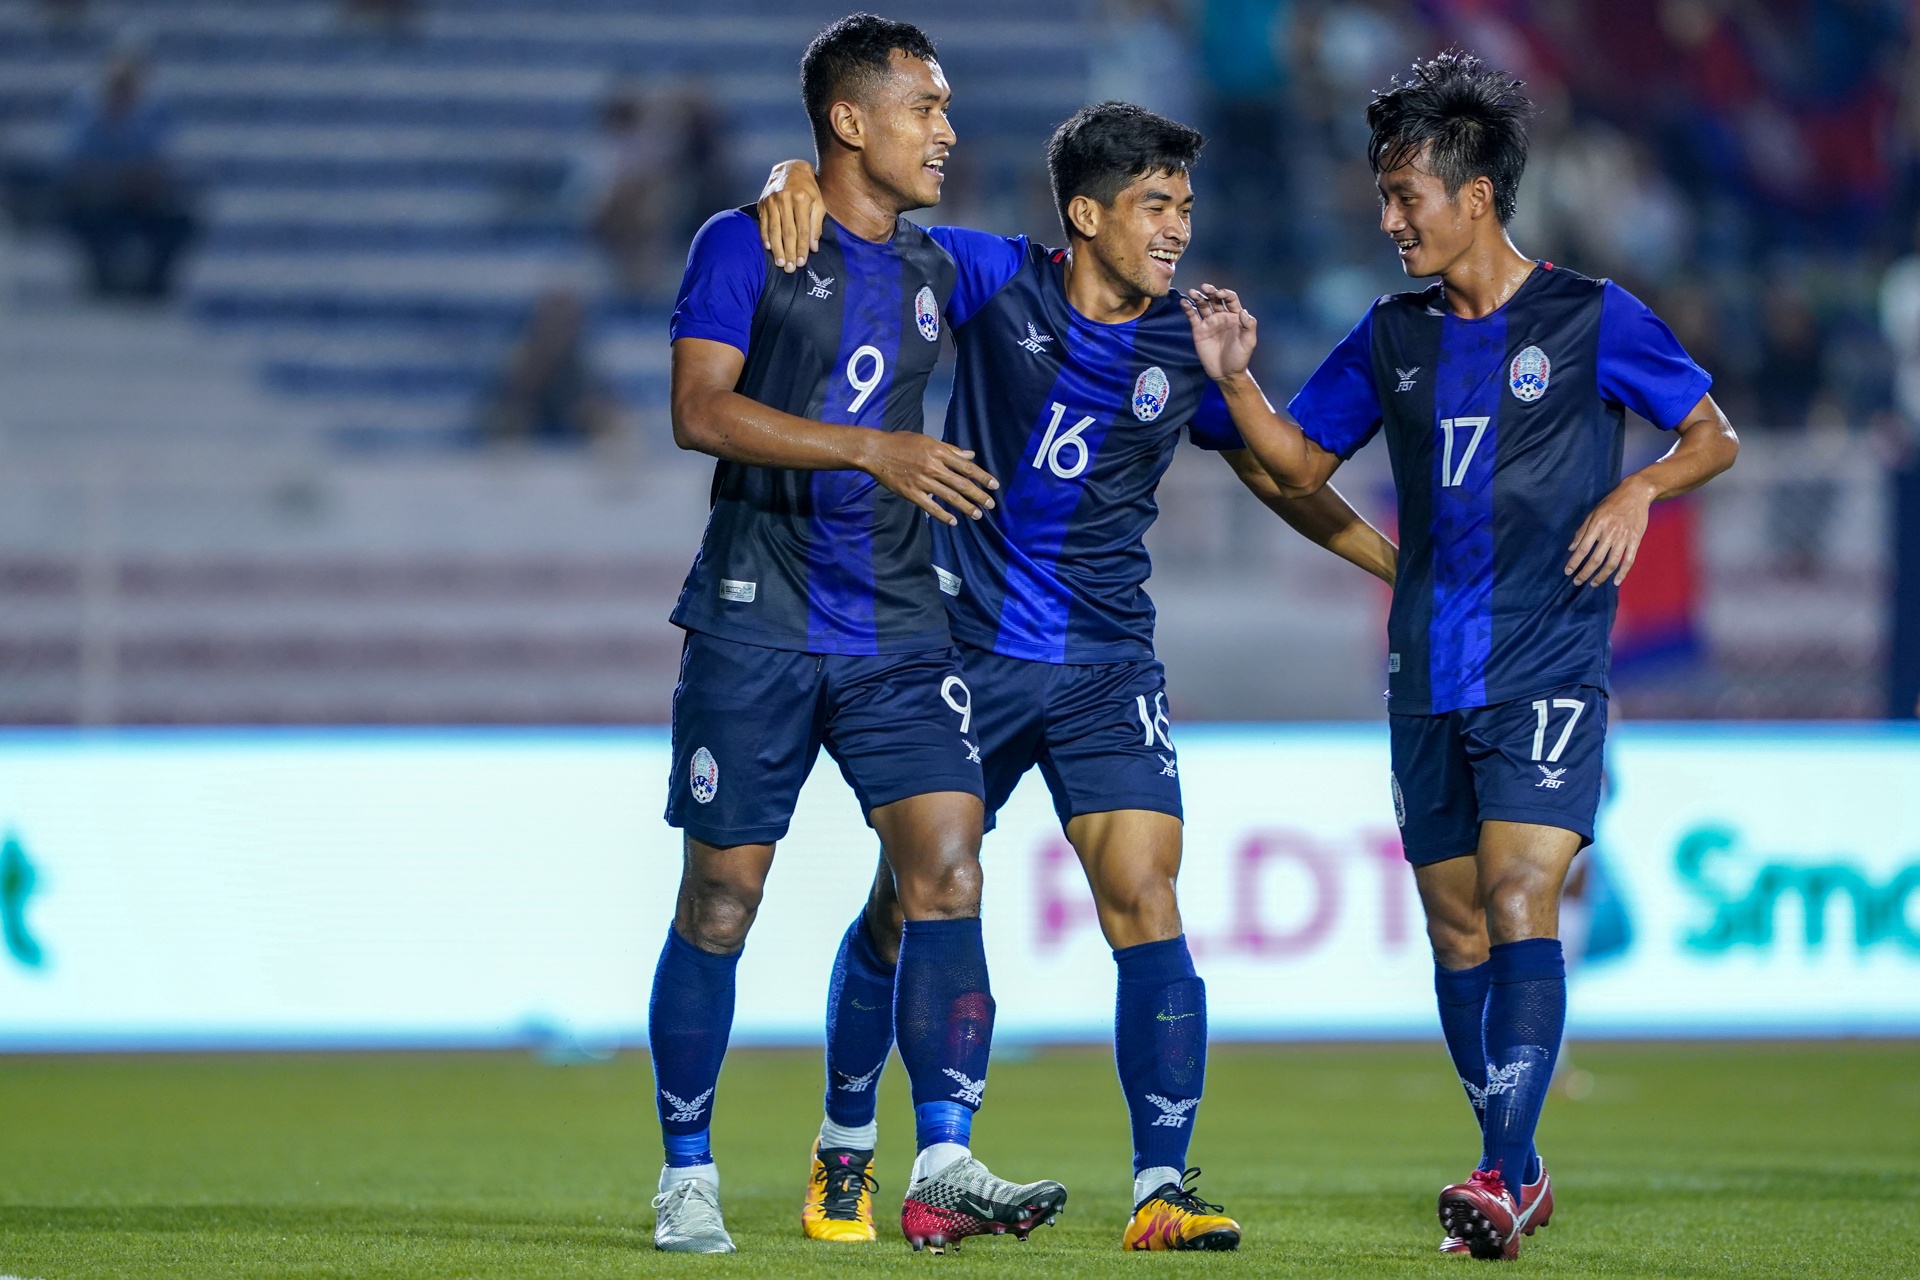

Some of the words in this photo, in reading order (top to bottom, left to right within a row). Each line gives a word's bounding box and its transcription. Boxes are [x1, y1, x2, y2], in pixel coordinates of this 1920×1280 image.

[807, 287, 833, 300] FBT
[1017, 338, 1047, 354] FBT
[846, 345, 885, 413] 9
[1395, 380, 1417, 392] FBT
[1519, 375, 1539, 384] FFC
[1032, 401, 1096, 479] 16
[1440, 416, 1491, 487] 17
[941, 675, 971, 734] 9
[1531, 698, 1586, 762] 17
[1159, 767, 1178, 778] FBT
[1535, 779, 1566, 789] FBT
[1032, 830, 1413, 955] PDT
[950, 1089, 983, 1106] FBT
[665, 1108, 706, 1122] FBT
[1151, 1114, 1188, 1128] FBT
